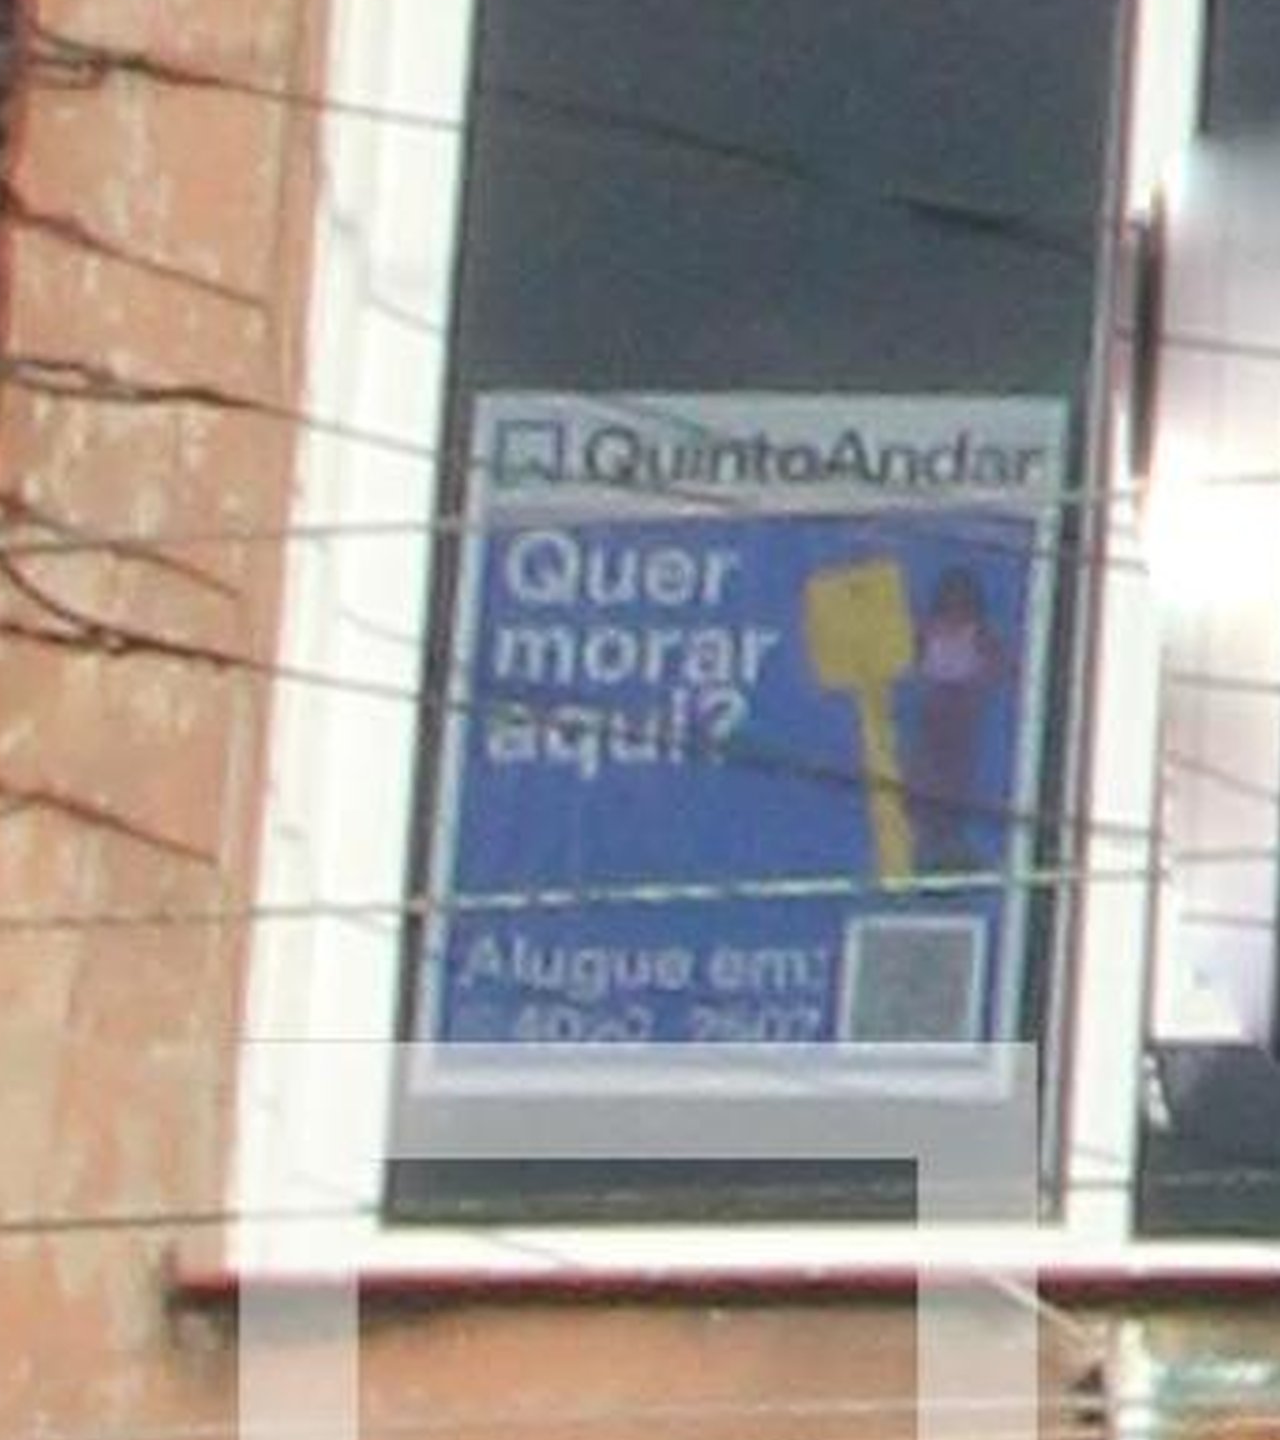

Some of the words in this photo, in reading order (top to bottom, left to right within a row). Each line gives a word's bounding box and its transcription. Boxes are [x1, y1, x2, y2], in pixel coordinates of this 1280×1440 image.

[586, 424, 1045, 488] QuintoAndar
[504, 528, 741, 606] Quer
[493, 624, 780, 684] morar
[456, 934, 696, 1001] Alugue
